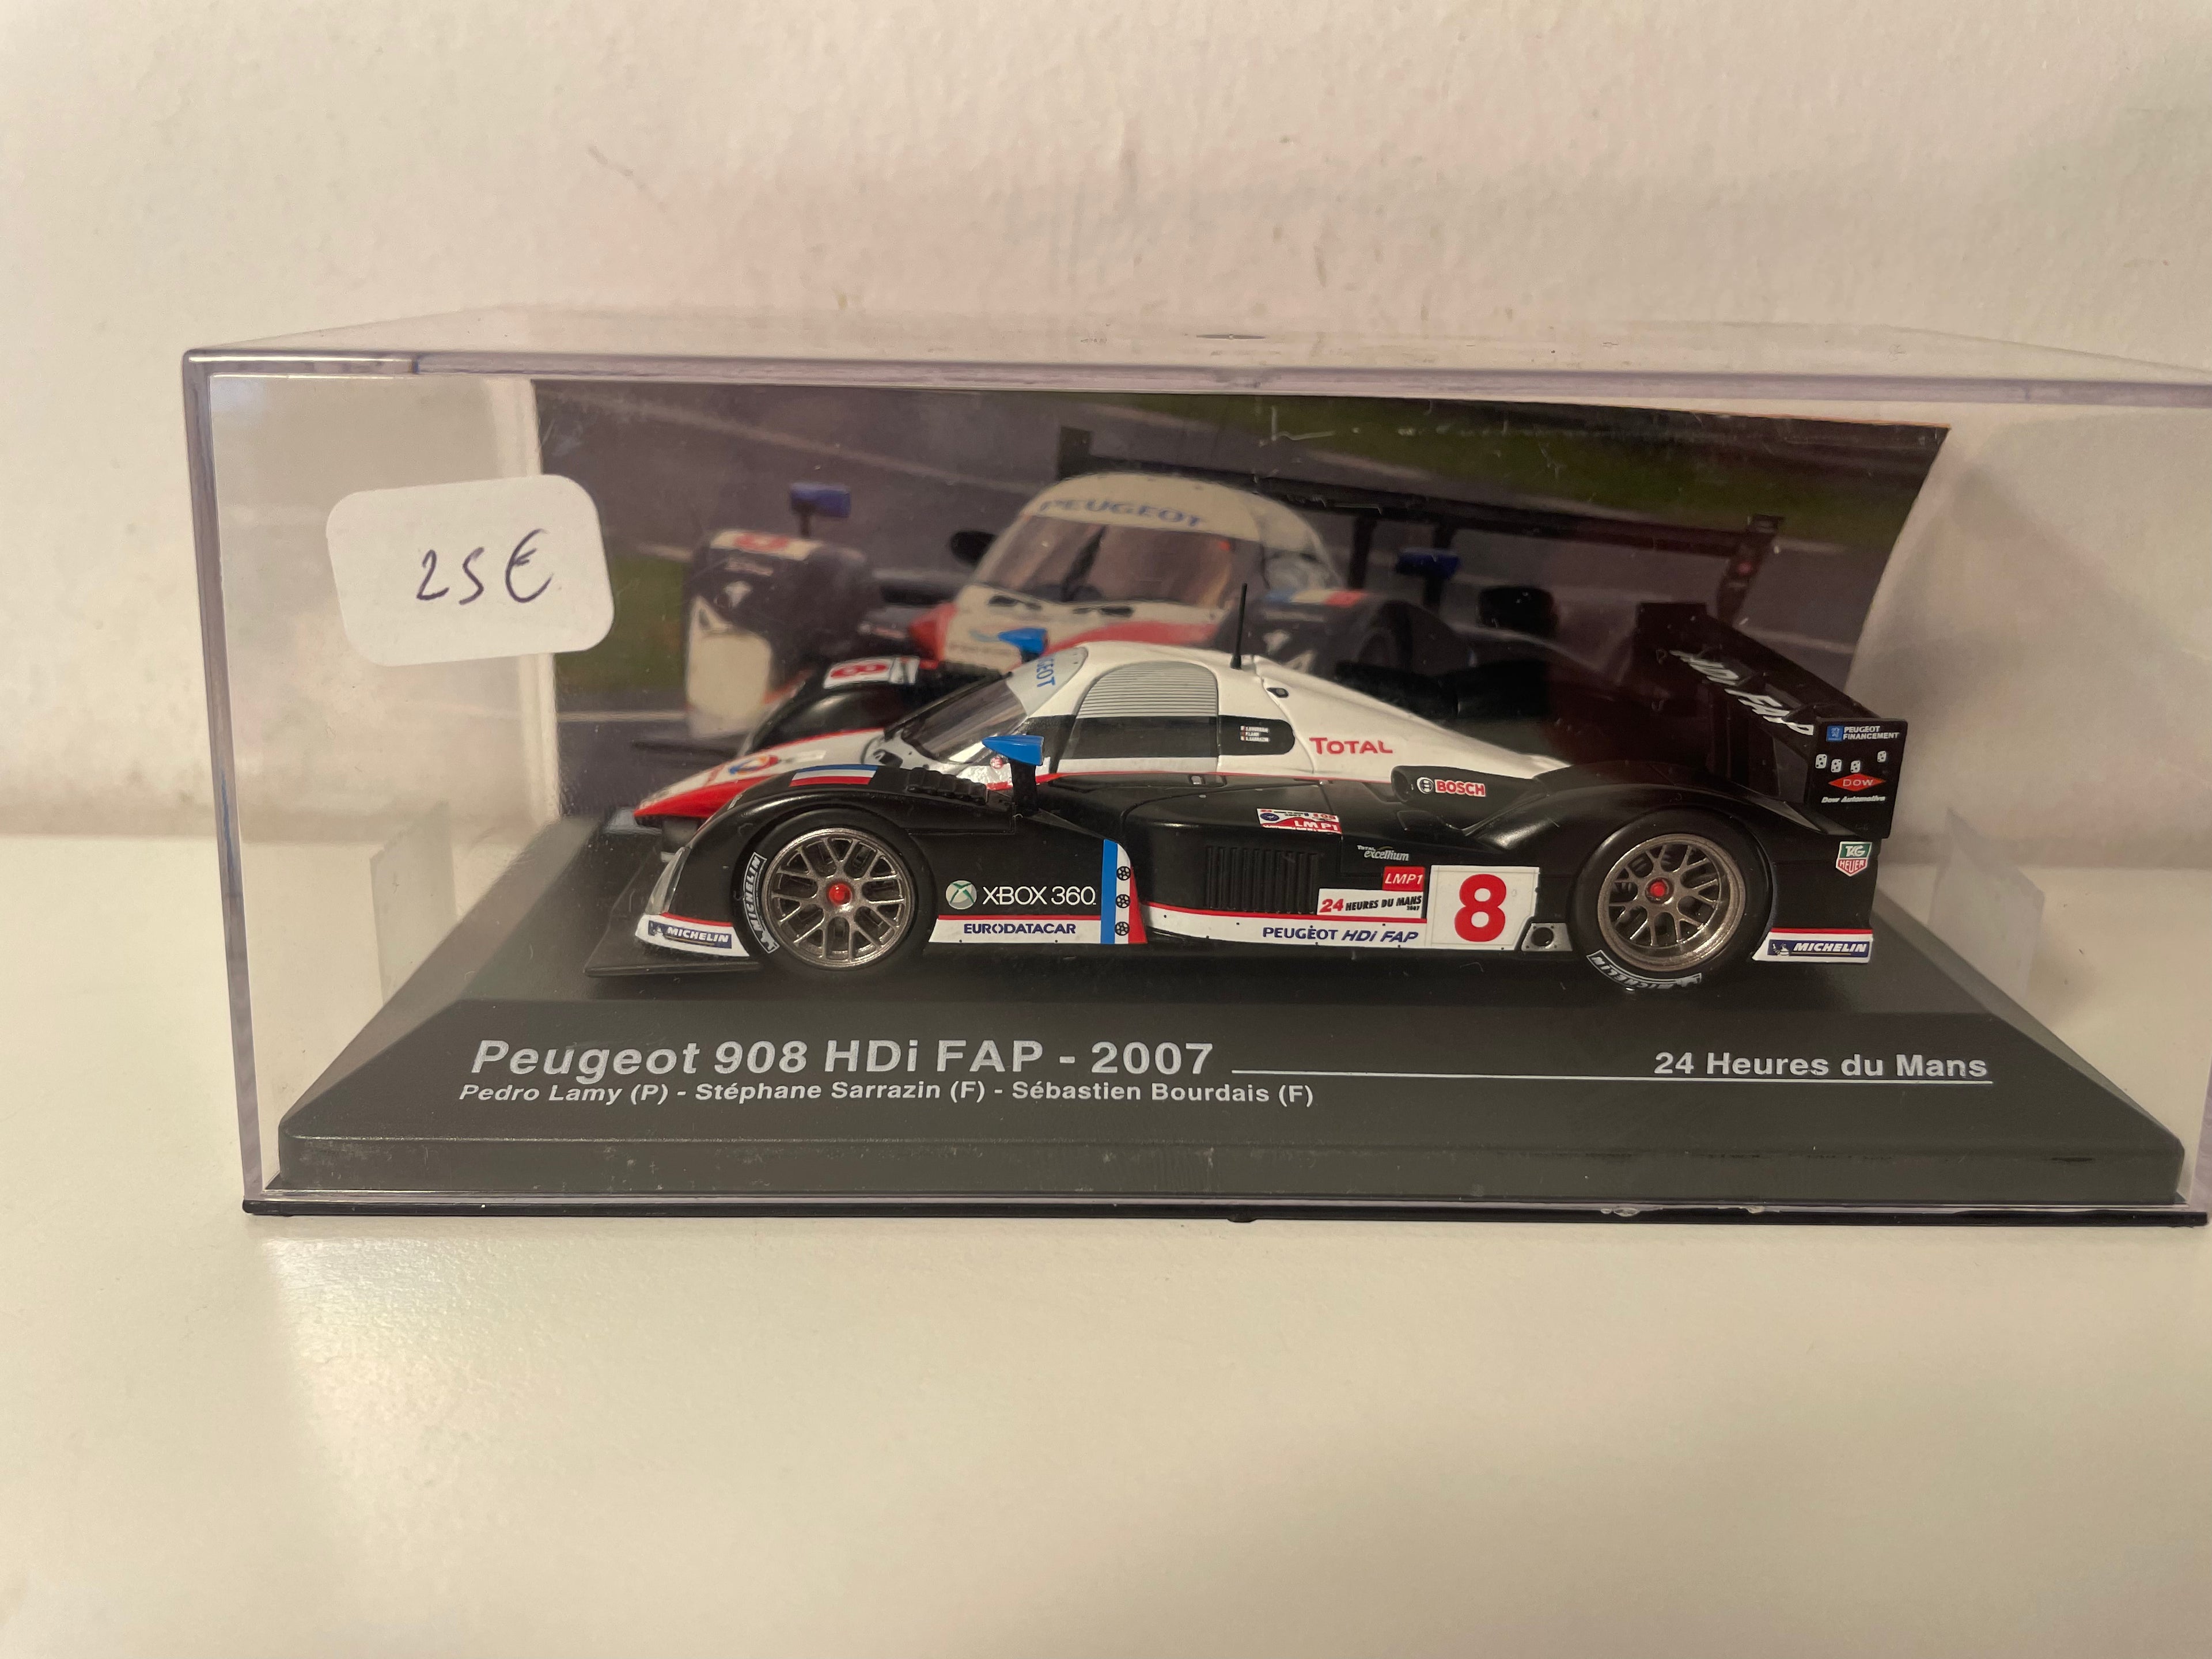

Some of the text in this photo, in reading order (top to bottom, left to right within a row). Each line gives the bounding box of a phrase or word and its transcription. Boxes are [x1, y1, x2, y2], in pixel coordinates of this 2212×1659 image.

[1843, 725, 1881, 733] PEUGEOT
[1843, 732, 1900, 740] FINANCEMENT
[1308, 737, 1393, 755] TOTAL
[1435, 779, 1486, 797] BOSCH
[1843, 779, 1873, 787] DOW
[1840, 795, 1886, 803] Automotive
[1364, 849, 1410, 862] excellium
[1845, 845, 1866, 857] TAG
[1839, 859, 1865, 873] HEUER
[1384, 873, 1424, 885] LMP1
[744, 856, 762, 932] MICHELIN
[982, 886, 1047, 905] XBOX
[1319, 895, 1422, 912] 24 HEURES DU MANS
[1454, 873, 1507, 942] 8
[666, 926, 729, 943] MICHELIN
[963, 923, 1077, 934] EURODATACAR
[1263, 926, 1419, 943] PEUGEOT HDi FAP
[1793, 942, 1867, 953] MICHELIN
[471, 1040, 700, 1085] Peugeot
[714, 1040, 808, 1074] 908
[824, 1039, 918, 1072] HDi
[937, 1040, 1043, 1072] FAP
[1091, 1041, 1213, 1075] 2007
[1654, 1052, 1987, 1077] 24 Heures du Mans
[459, 1084, 540, 1101] Pedro
[548, 1085, 623, 1105] Lamy
[630, 1084, 668, 1105] (P)
[695, 1081, 821, 1104] Stéphane
[831, 1081, 941, 1099] Sarrazin
[950, 1081, 985, 1103] (F)
[1012, 1080, 1141, 1100] Sébastien
[1152, 1082, 1270, 1102] Bourdais
[1278, 1085, 1314, 1107] (F)
